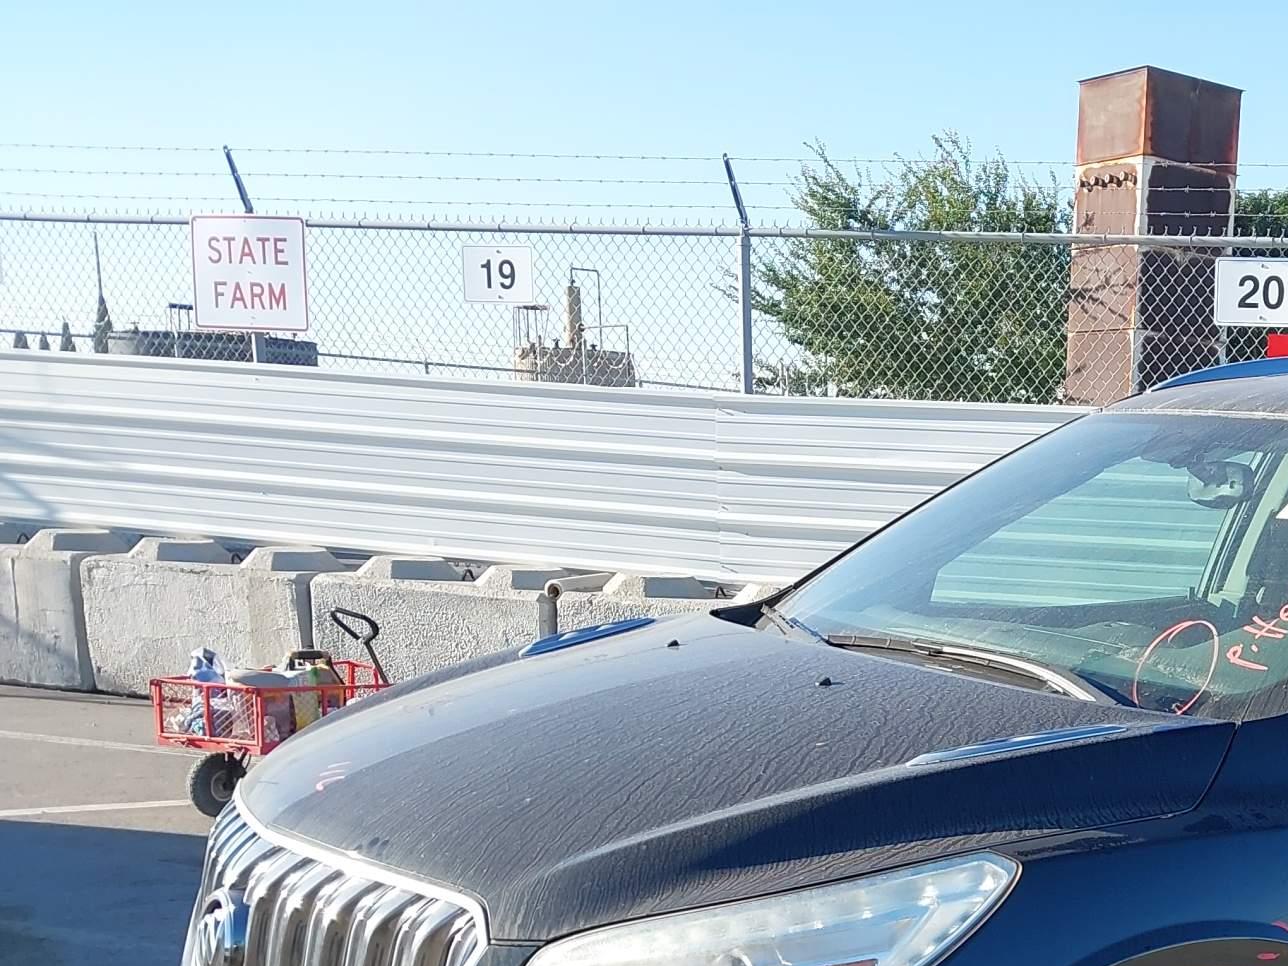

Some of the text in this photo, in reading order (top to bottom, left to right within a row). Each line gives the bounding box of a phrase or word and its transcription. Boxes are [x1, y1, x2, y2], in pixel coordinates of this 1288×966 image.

[207, 236, 289, 266] STATE
[480, 258, 516, 290] 19
[213, 280, 288, 312] FARM
[1237, 274, 1285, 310] 20
